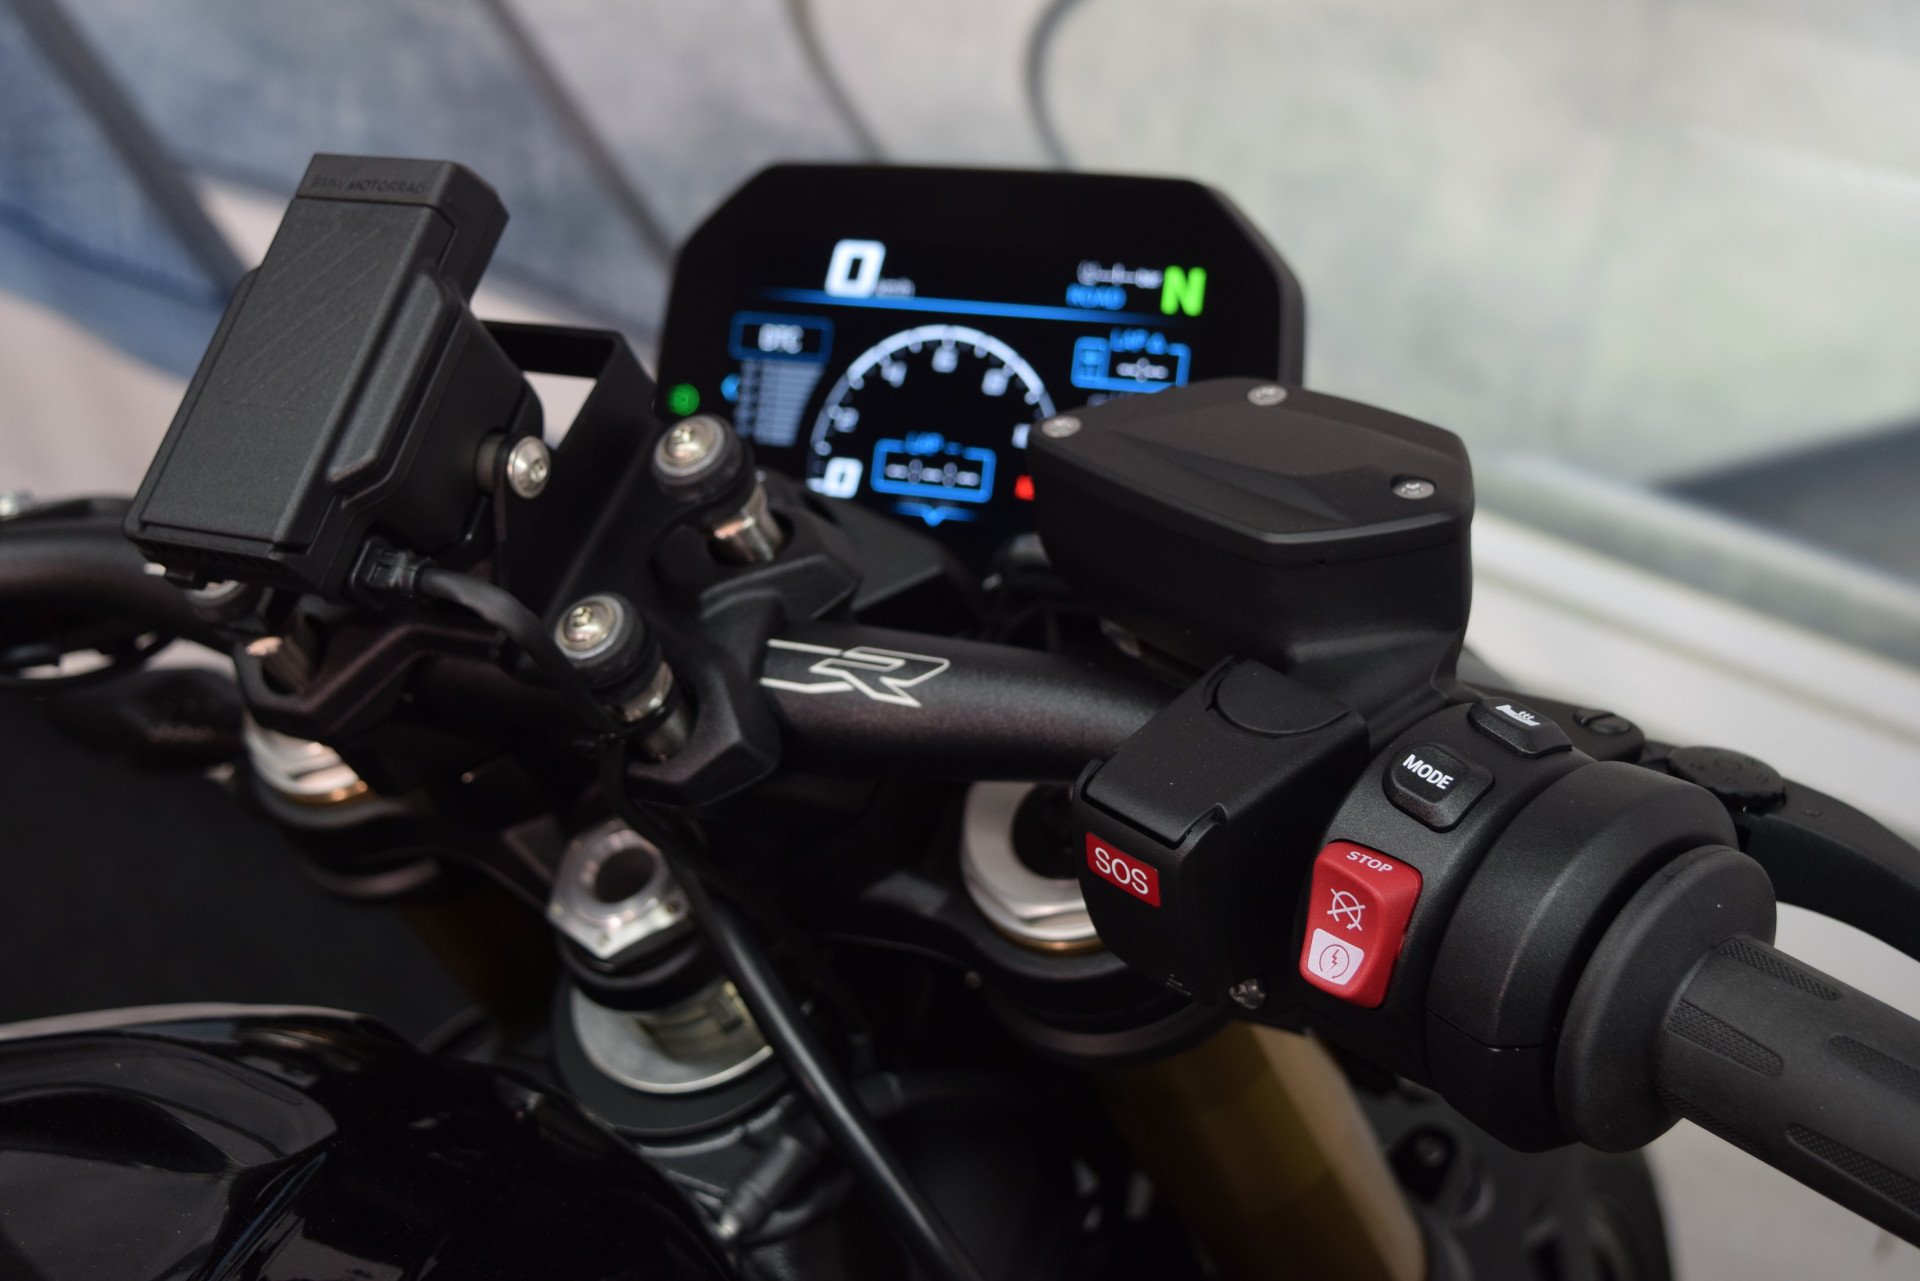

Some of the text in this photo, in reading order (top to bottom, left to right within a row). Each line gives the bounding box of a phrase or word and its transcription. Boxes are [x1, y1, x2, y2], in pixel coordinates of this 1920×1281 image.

[824, 238, 887, 299] 0
[1160, 265, 1207, 317] N
[1402, 753, 1455, 790] MODE
[1094, 846, 1149, 895] SOS
[1346, 851, 1394, 872] STOP
